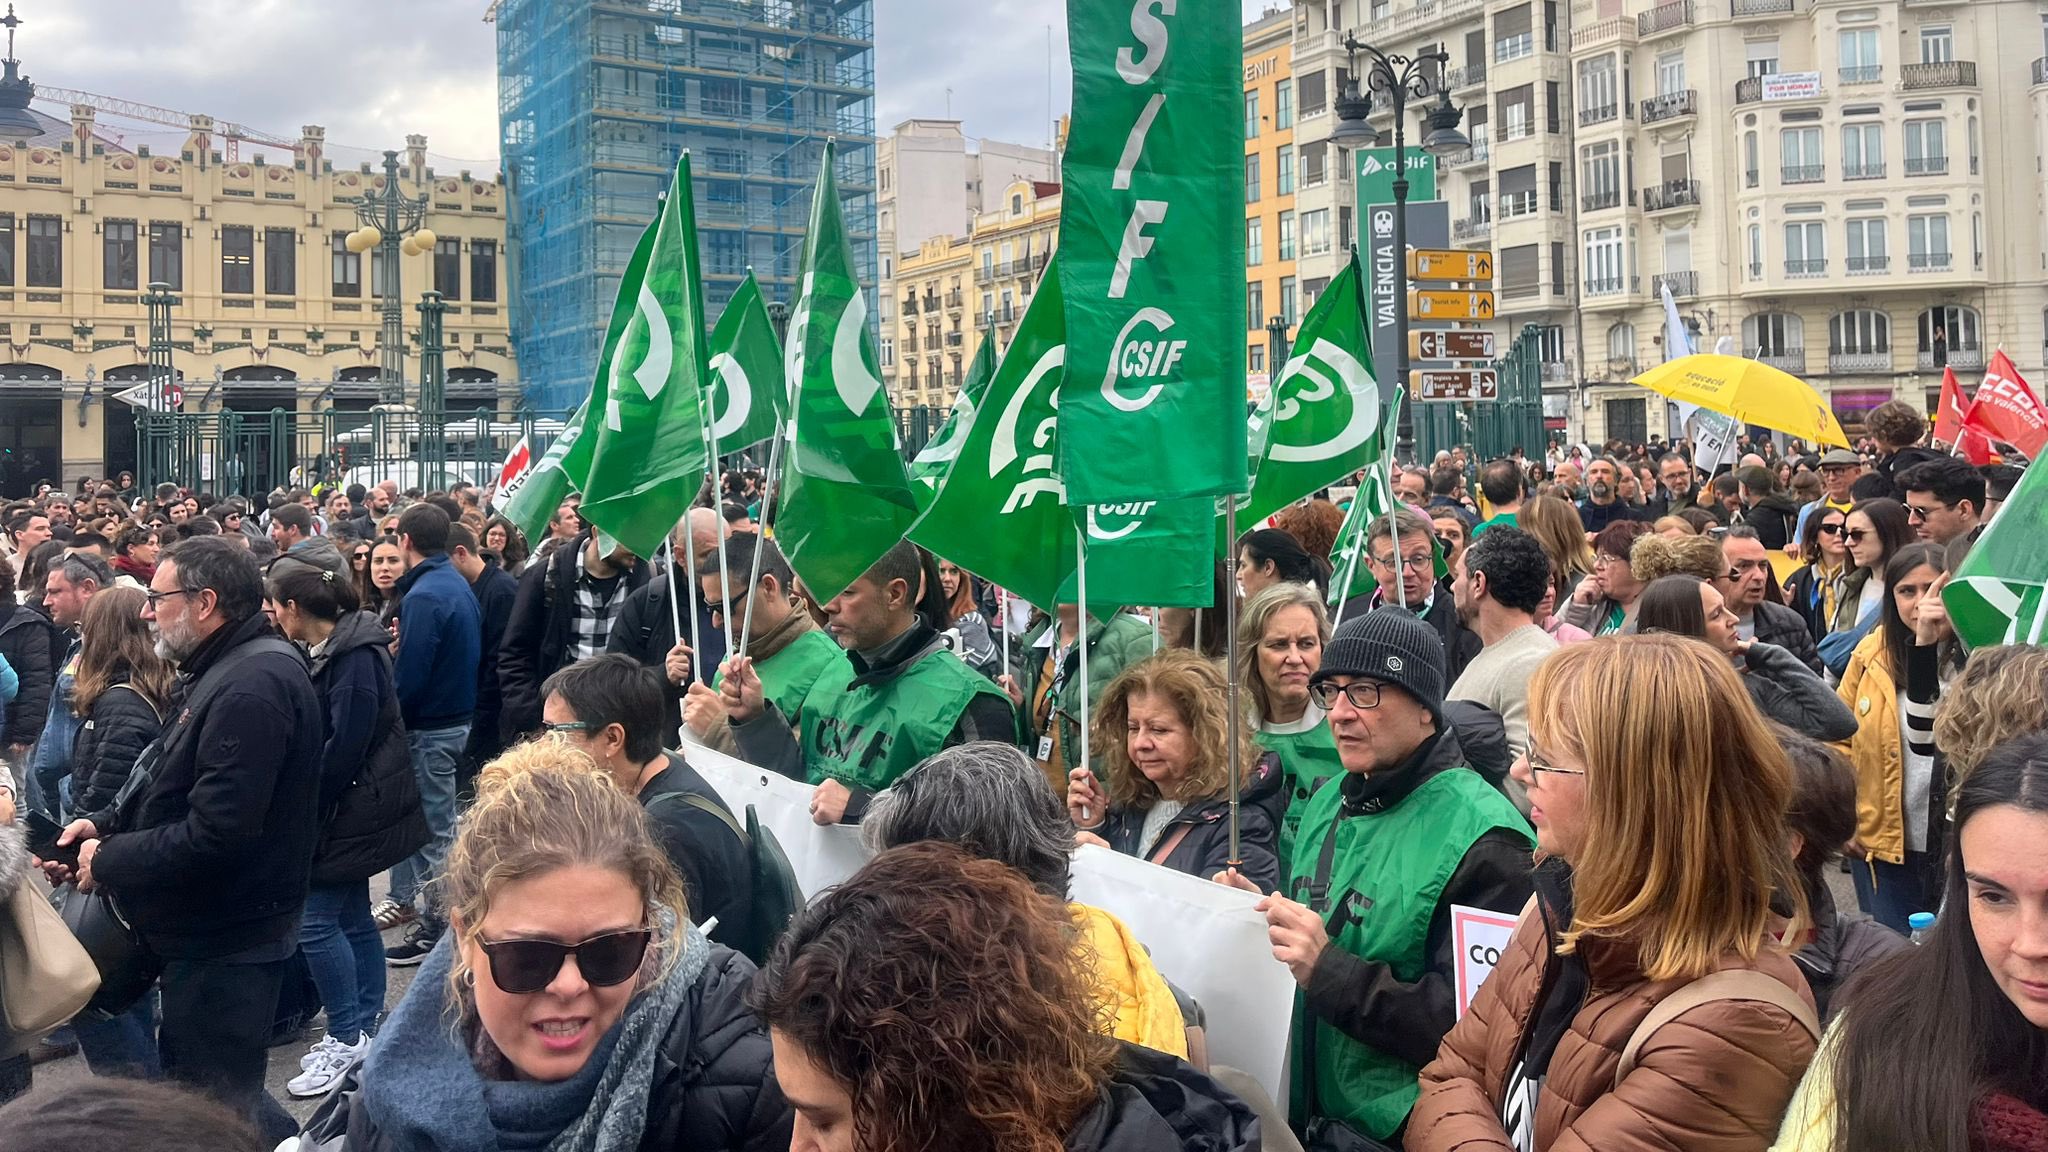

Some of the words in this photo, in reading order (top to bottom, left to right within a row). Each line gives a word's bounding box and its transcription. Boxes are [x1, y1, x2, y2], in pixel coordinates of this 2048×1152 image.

[1243, 55, 1278, 83] ENIT
[1373, 244, 1396, 328] VALÈNCIA
[1121, 340, 1187, 378] CSIF
